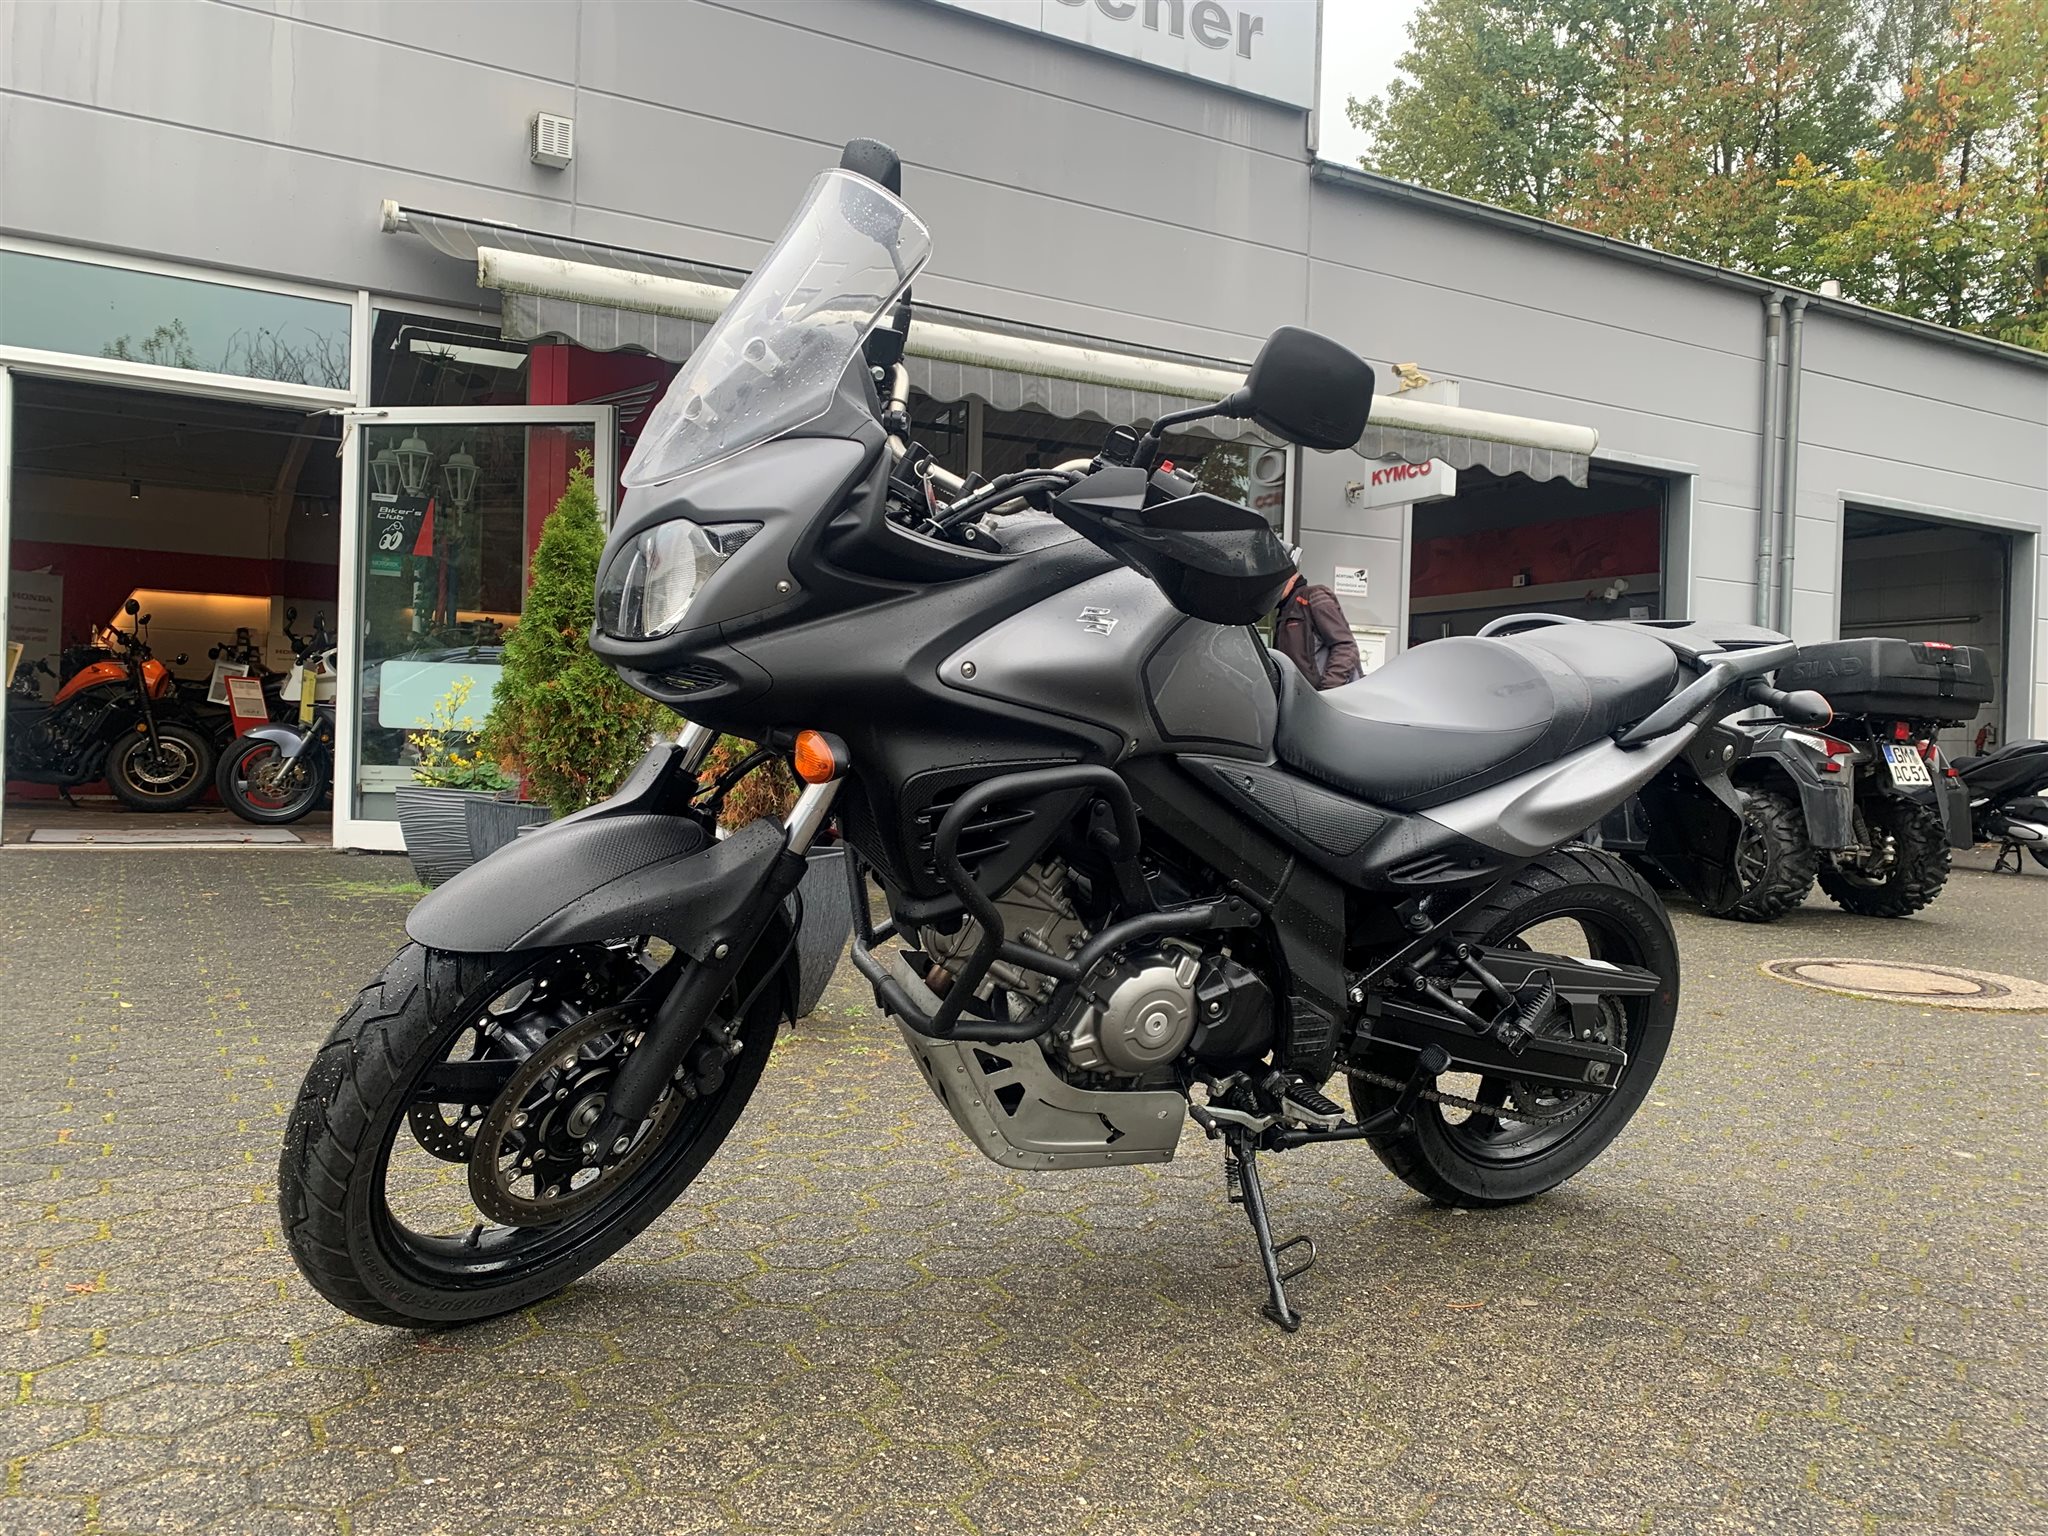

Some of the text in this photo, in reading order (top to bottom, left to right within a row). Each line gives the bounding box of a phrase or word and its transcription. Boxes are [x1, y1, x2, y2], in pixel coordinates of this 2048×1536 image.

[1056, 0, 1263, 59] her
[1371, 460, 1432, 486] KYMCO
[377, 512, 404, 520] Club
[379, 506, 422, 516] Biker's
[12, 592, 54, 603] HONDA
[1893, 747, 1912, 763] GM
